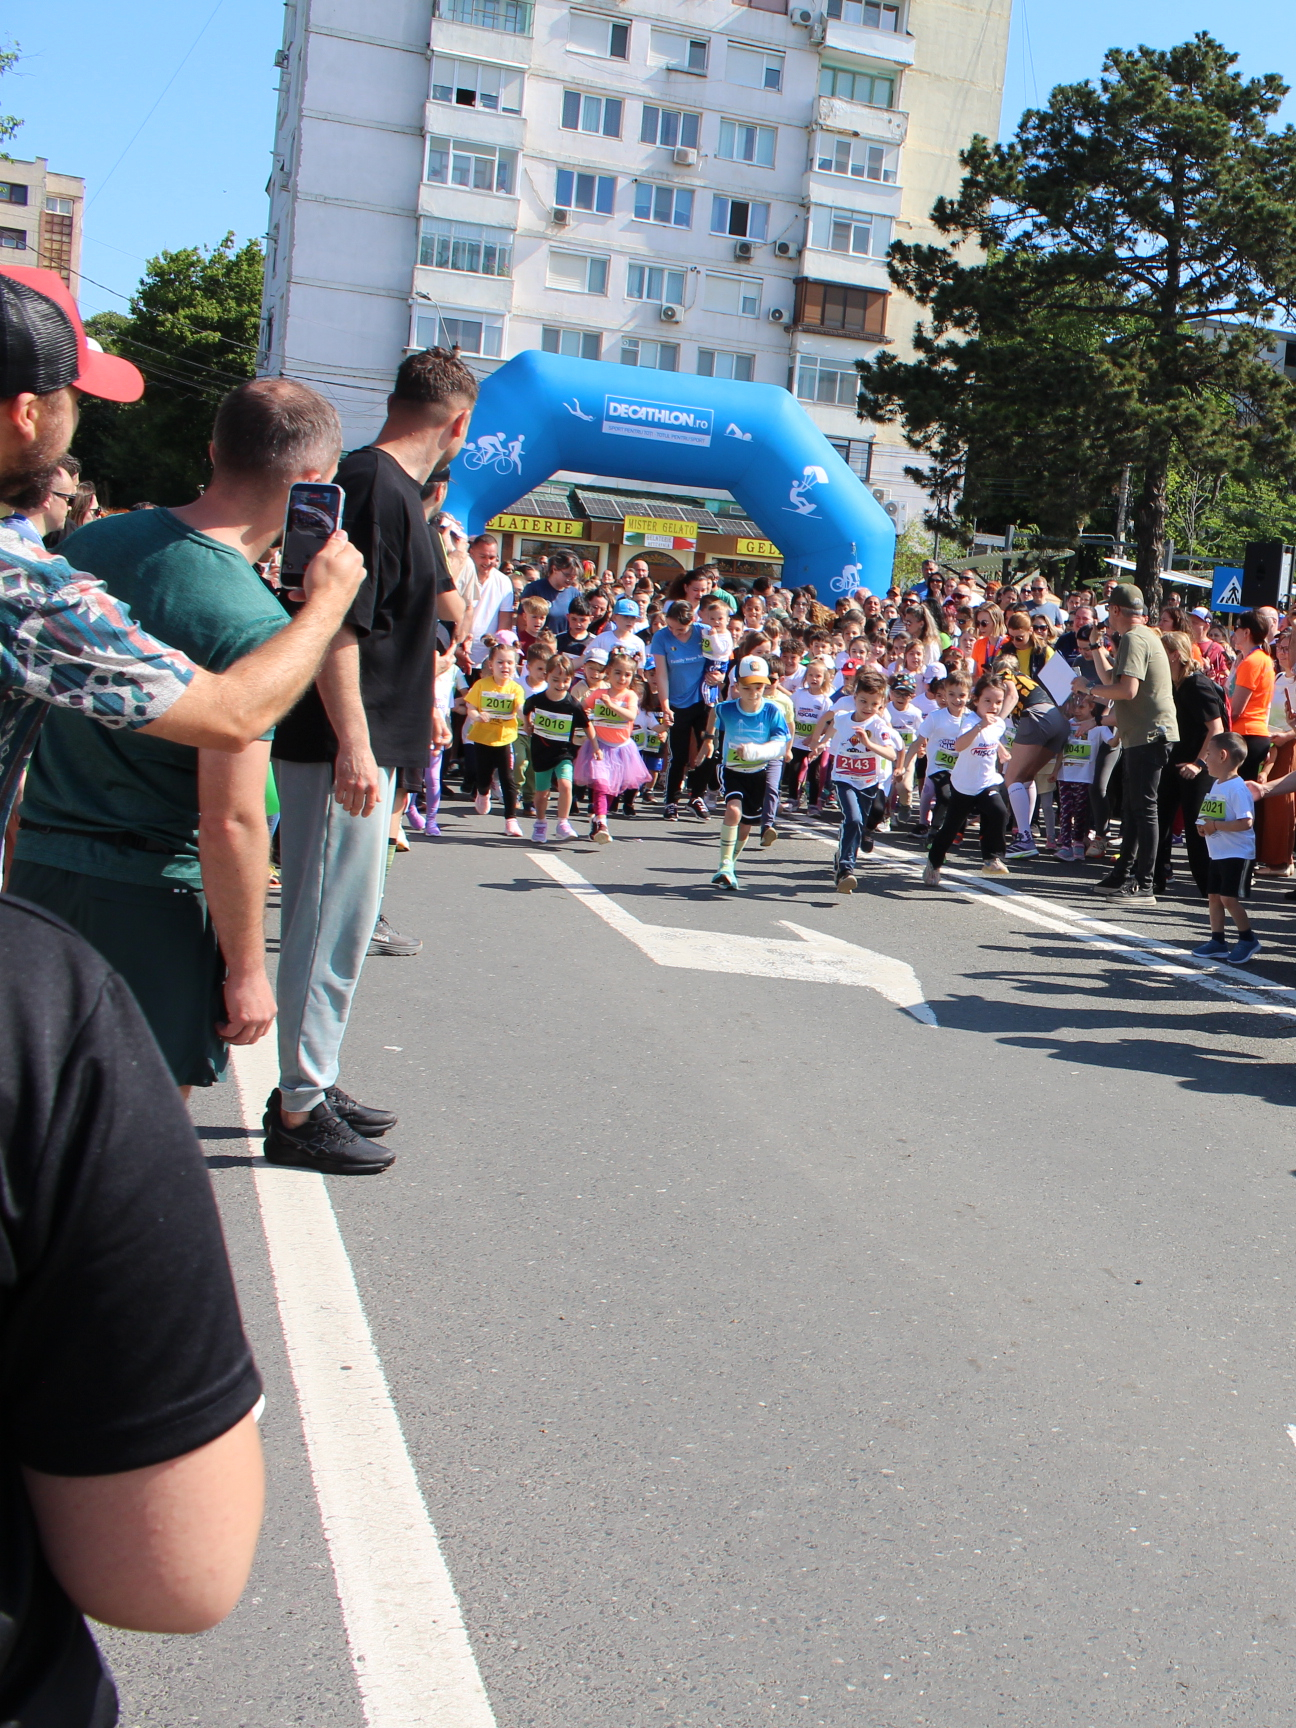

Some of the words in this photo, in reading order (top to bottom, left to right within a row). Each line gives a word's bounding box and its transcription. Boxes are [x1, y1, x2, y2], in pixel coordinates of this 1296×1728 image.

[609, 402, 709, 430] DECATHLON.ro
[486, 516, 573, 534] ELATERIE
[628, 518, 658, 532] MISTER
[662, 522, 695, 536] GELATO
[486, 698, 513, 709] 2017
[539, 716, 565, 730] 2016
[1064, 745, 1085, 754] 2041
[841, 757, 870, 770] 2143
[1201, 801, 1223, 814] 2021
